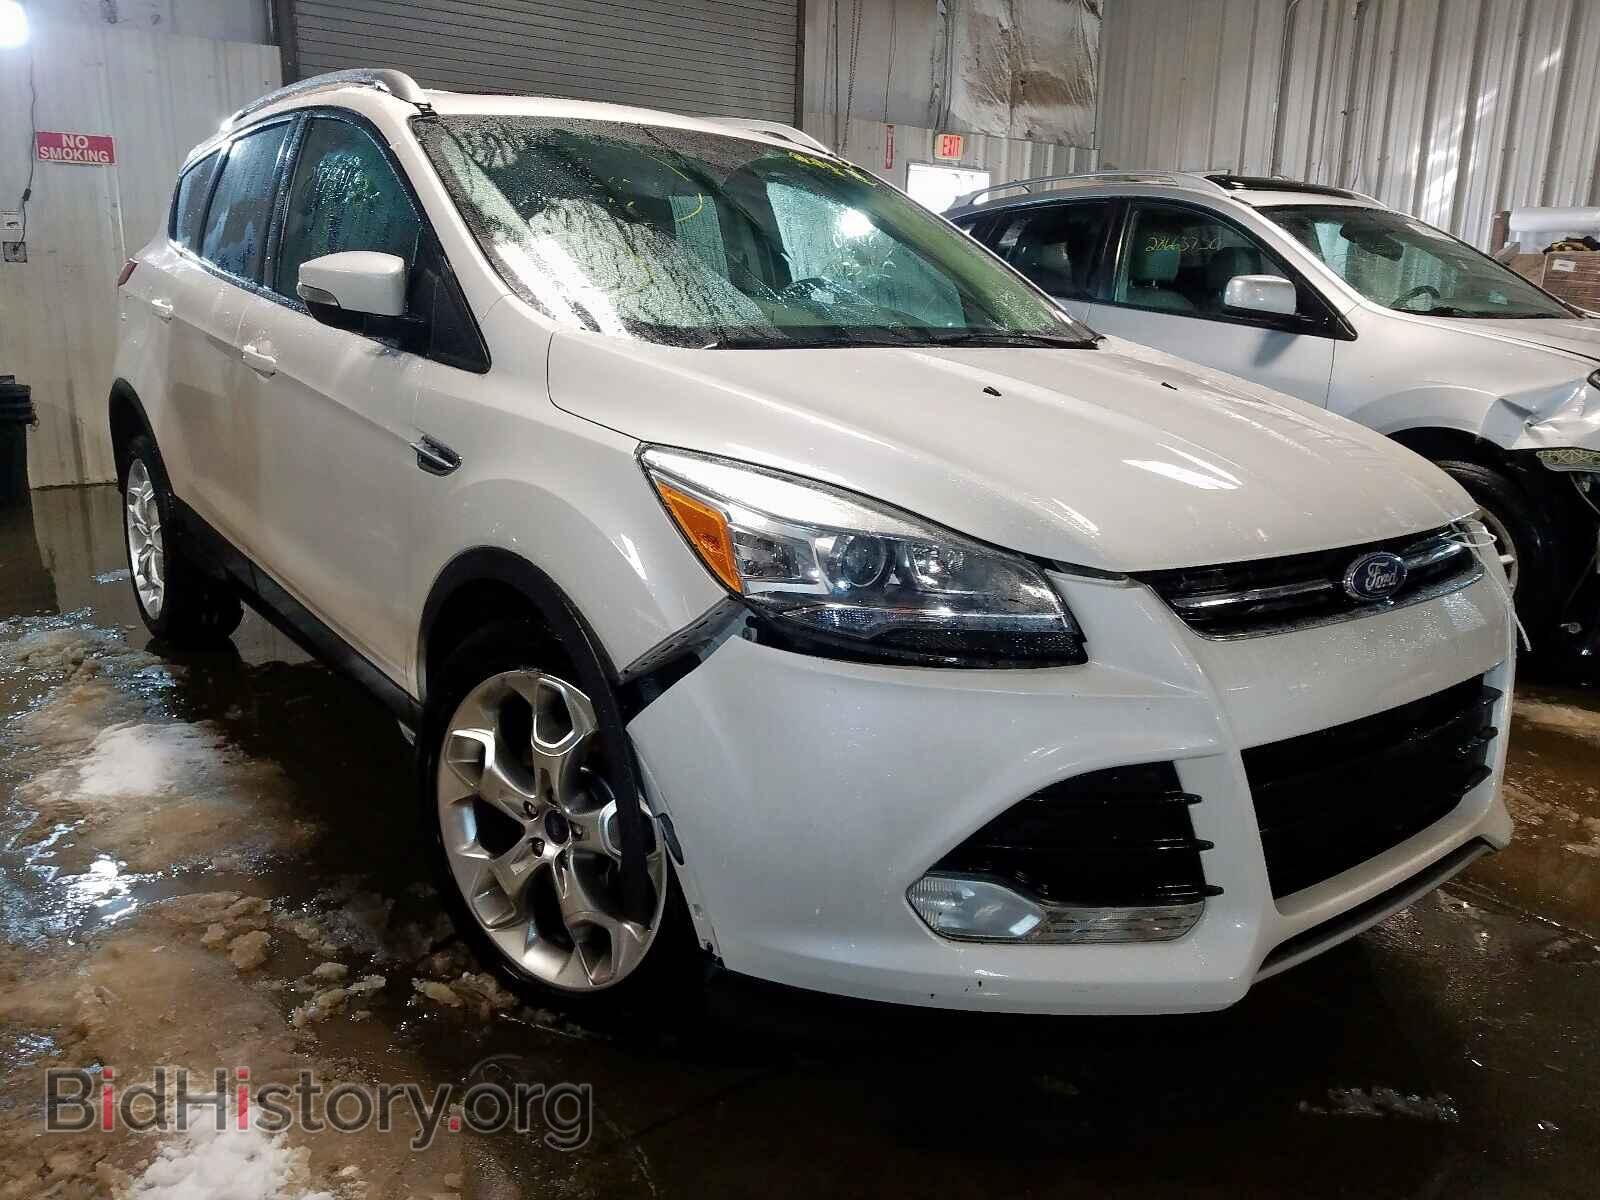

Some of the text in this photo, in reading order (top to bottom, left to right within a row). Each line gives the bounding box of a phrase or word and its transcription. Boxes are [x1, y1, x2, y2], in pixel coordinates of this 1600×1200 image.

[62, 134, 89, 148] NO
[942, 135, 961, 157] EXIT
[39, 146, 110, 162] SMOKING
[1365, 562, 1398, 591] Ford
